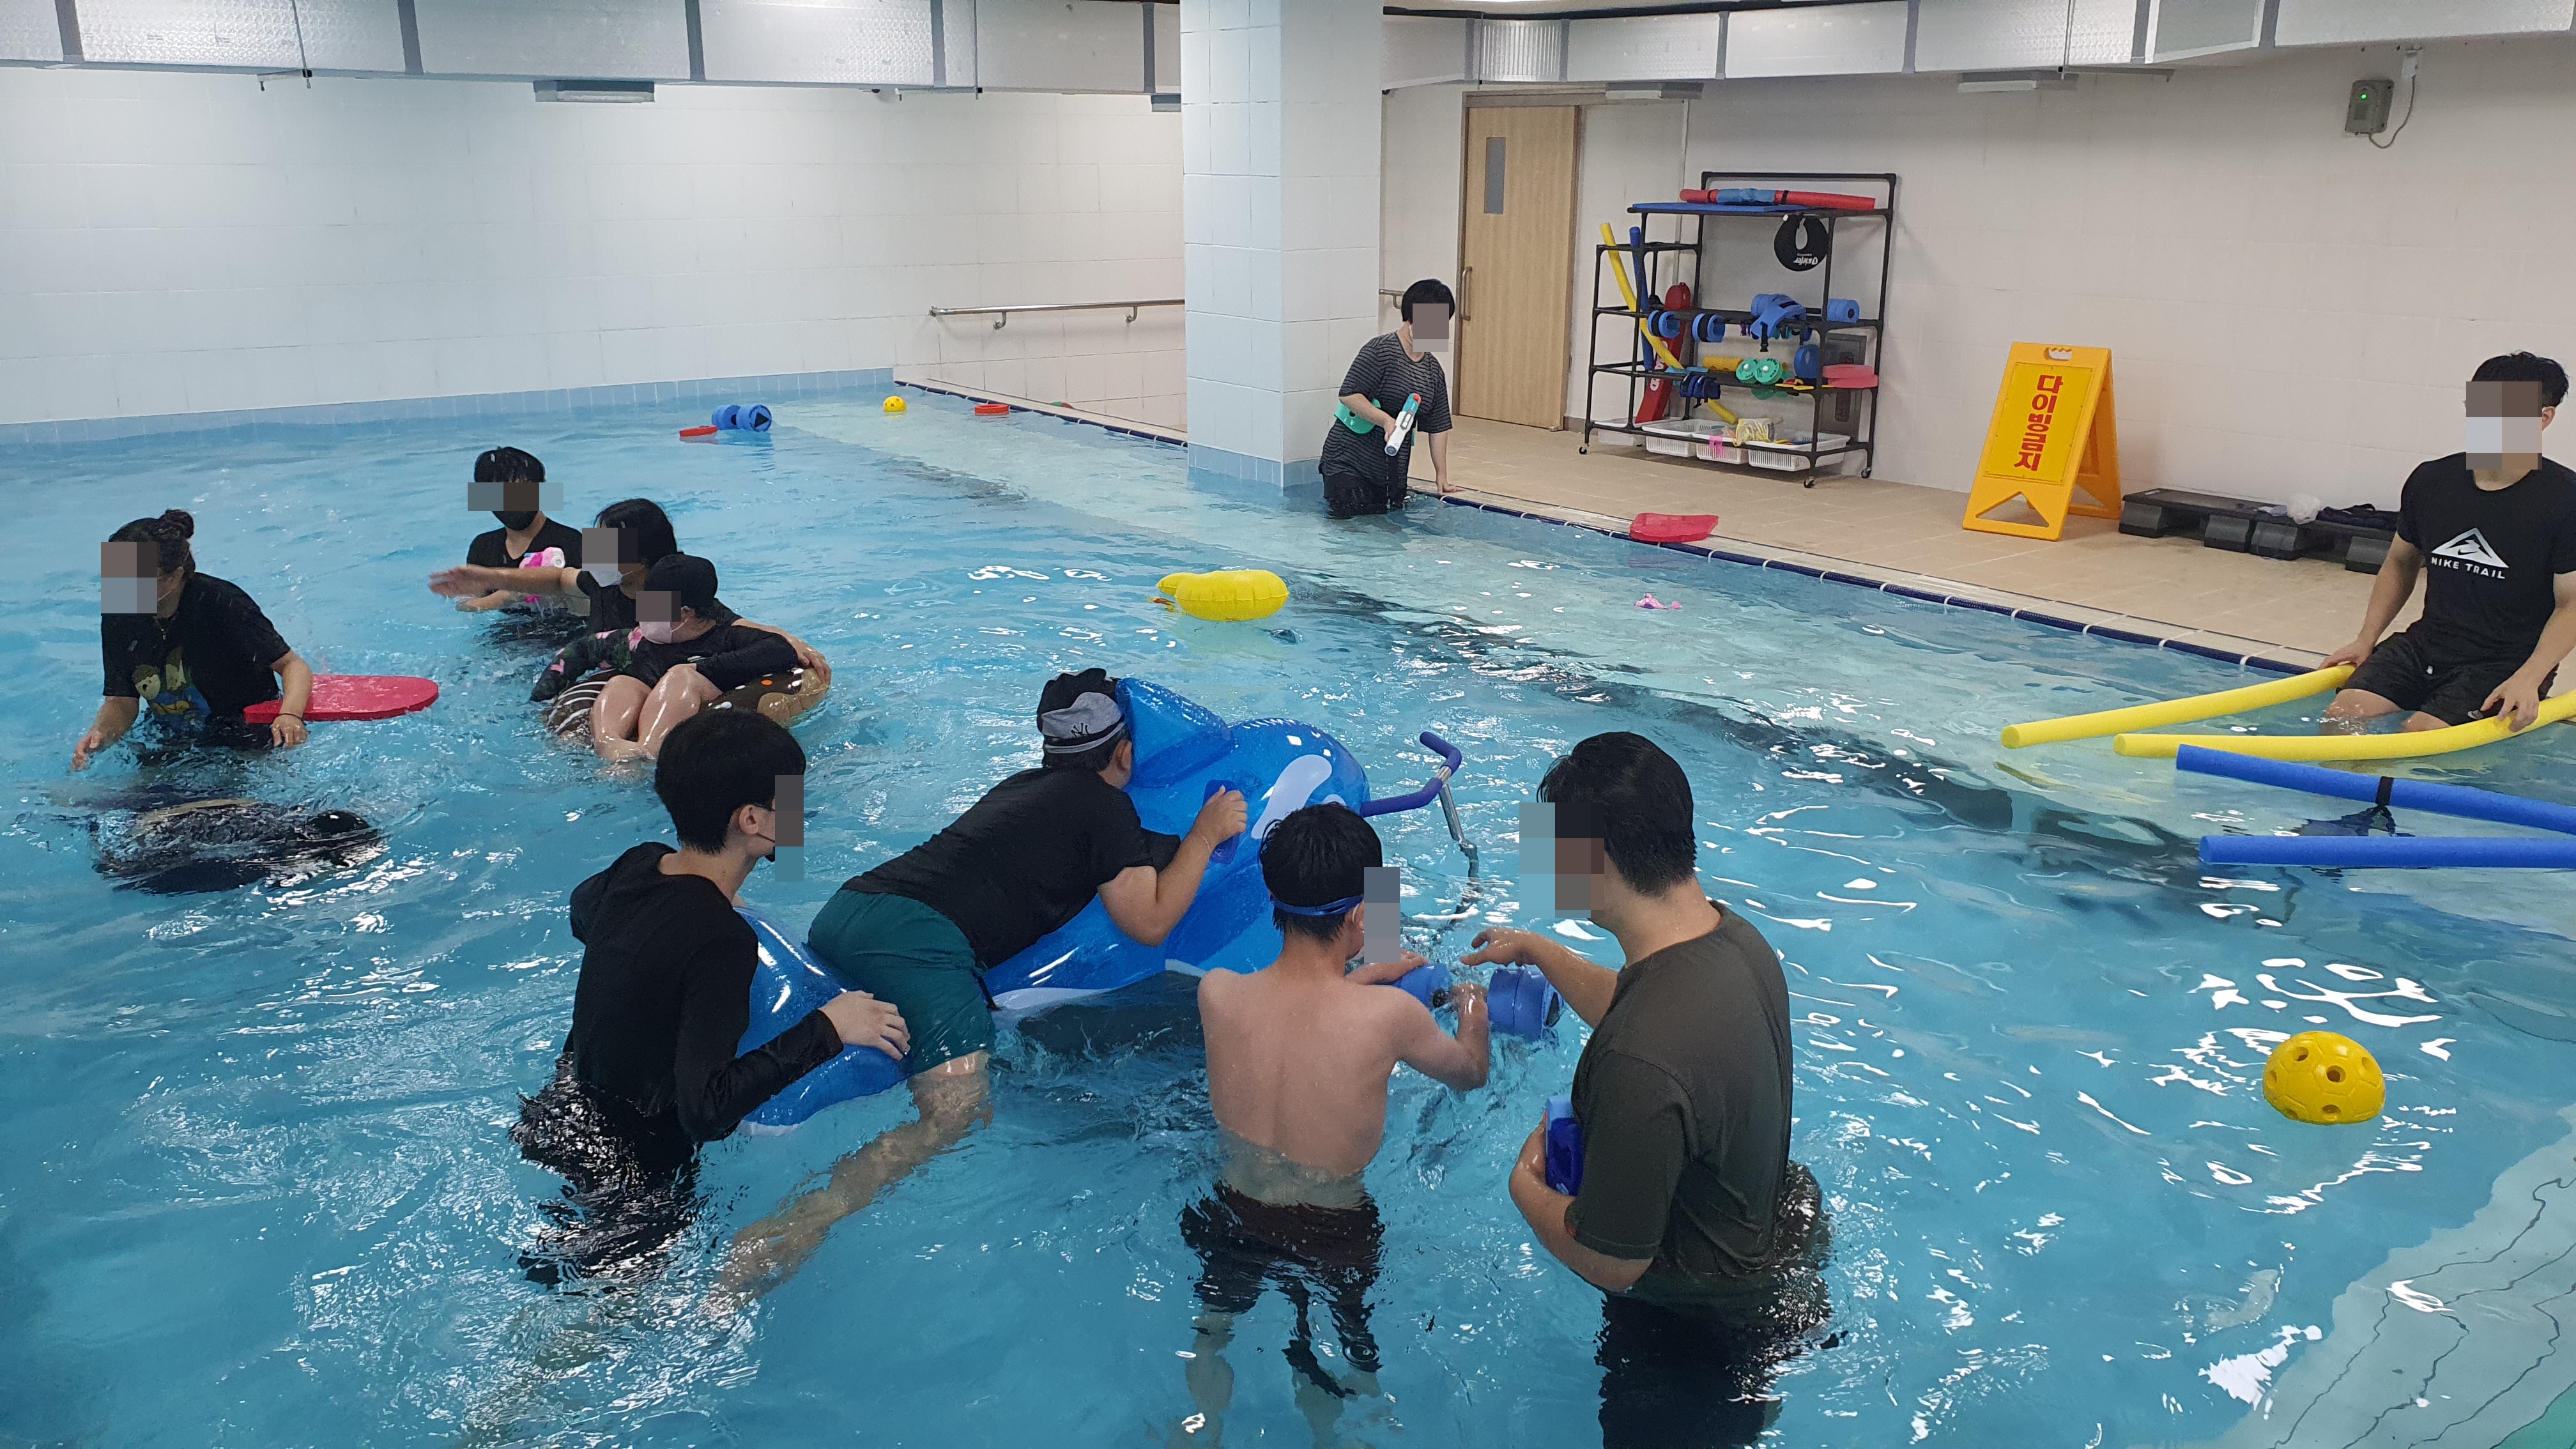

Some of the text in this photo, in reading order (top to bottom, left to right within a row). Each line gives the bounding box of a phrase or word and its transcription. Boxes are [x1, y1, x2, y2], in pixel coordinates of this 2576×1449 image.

[2014, 374, 2064, 471] 다이빙금지
[2431, 556, 2506, 579] NIKE TRAIL
